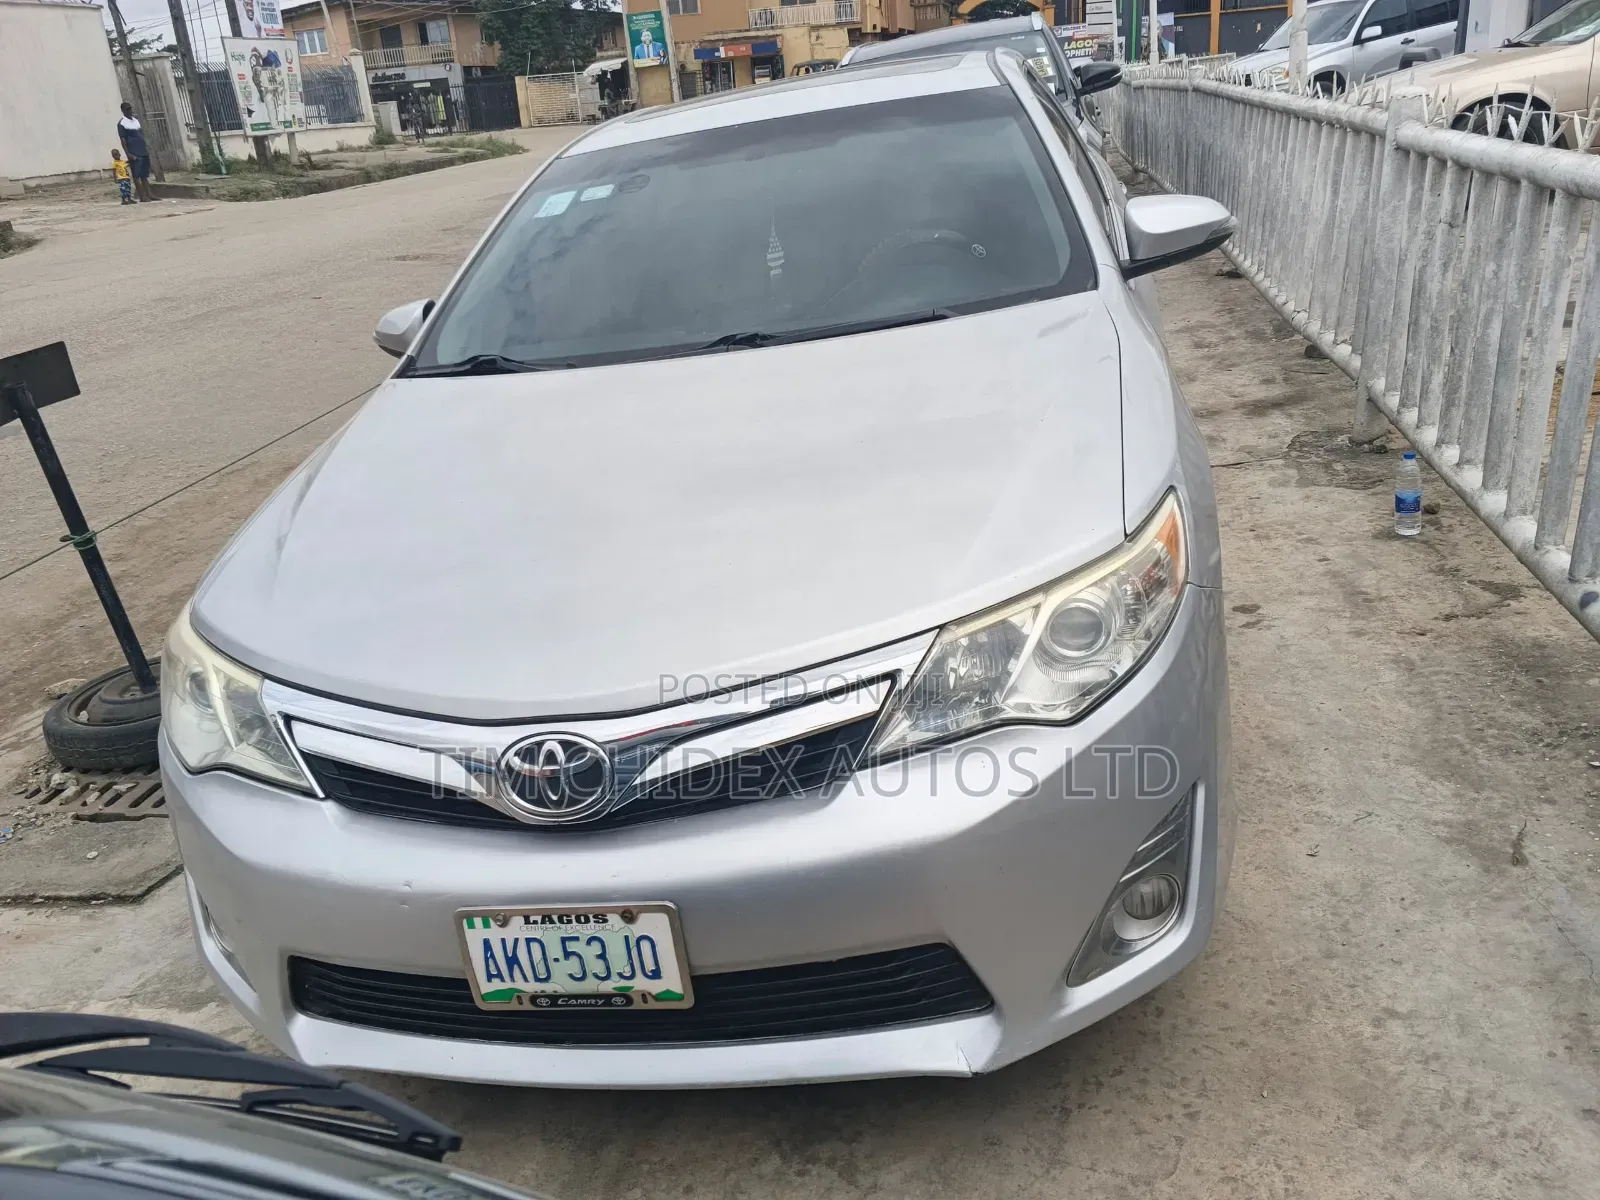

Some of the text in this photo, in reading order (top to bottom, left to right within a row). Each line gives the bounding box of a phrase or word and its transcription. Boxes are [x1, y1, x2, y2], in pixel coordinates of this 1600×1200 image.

[523, 913, 609, 925] LAGOS
[565, 923, 616, 932] EXCELLENCE
[482, 934, 663, 983] AKD-53JQ
